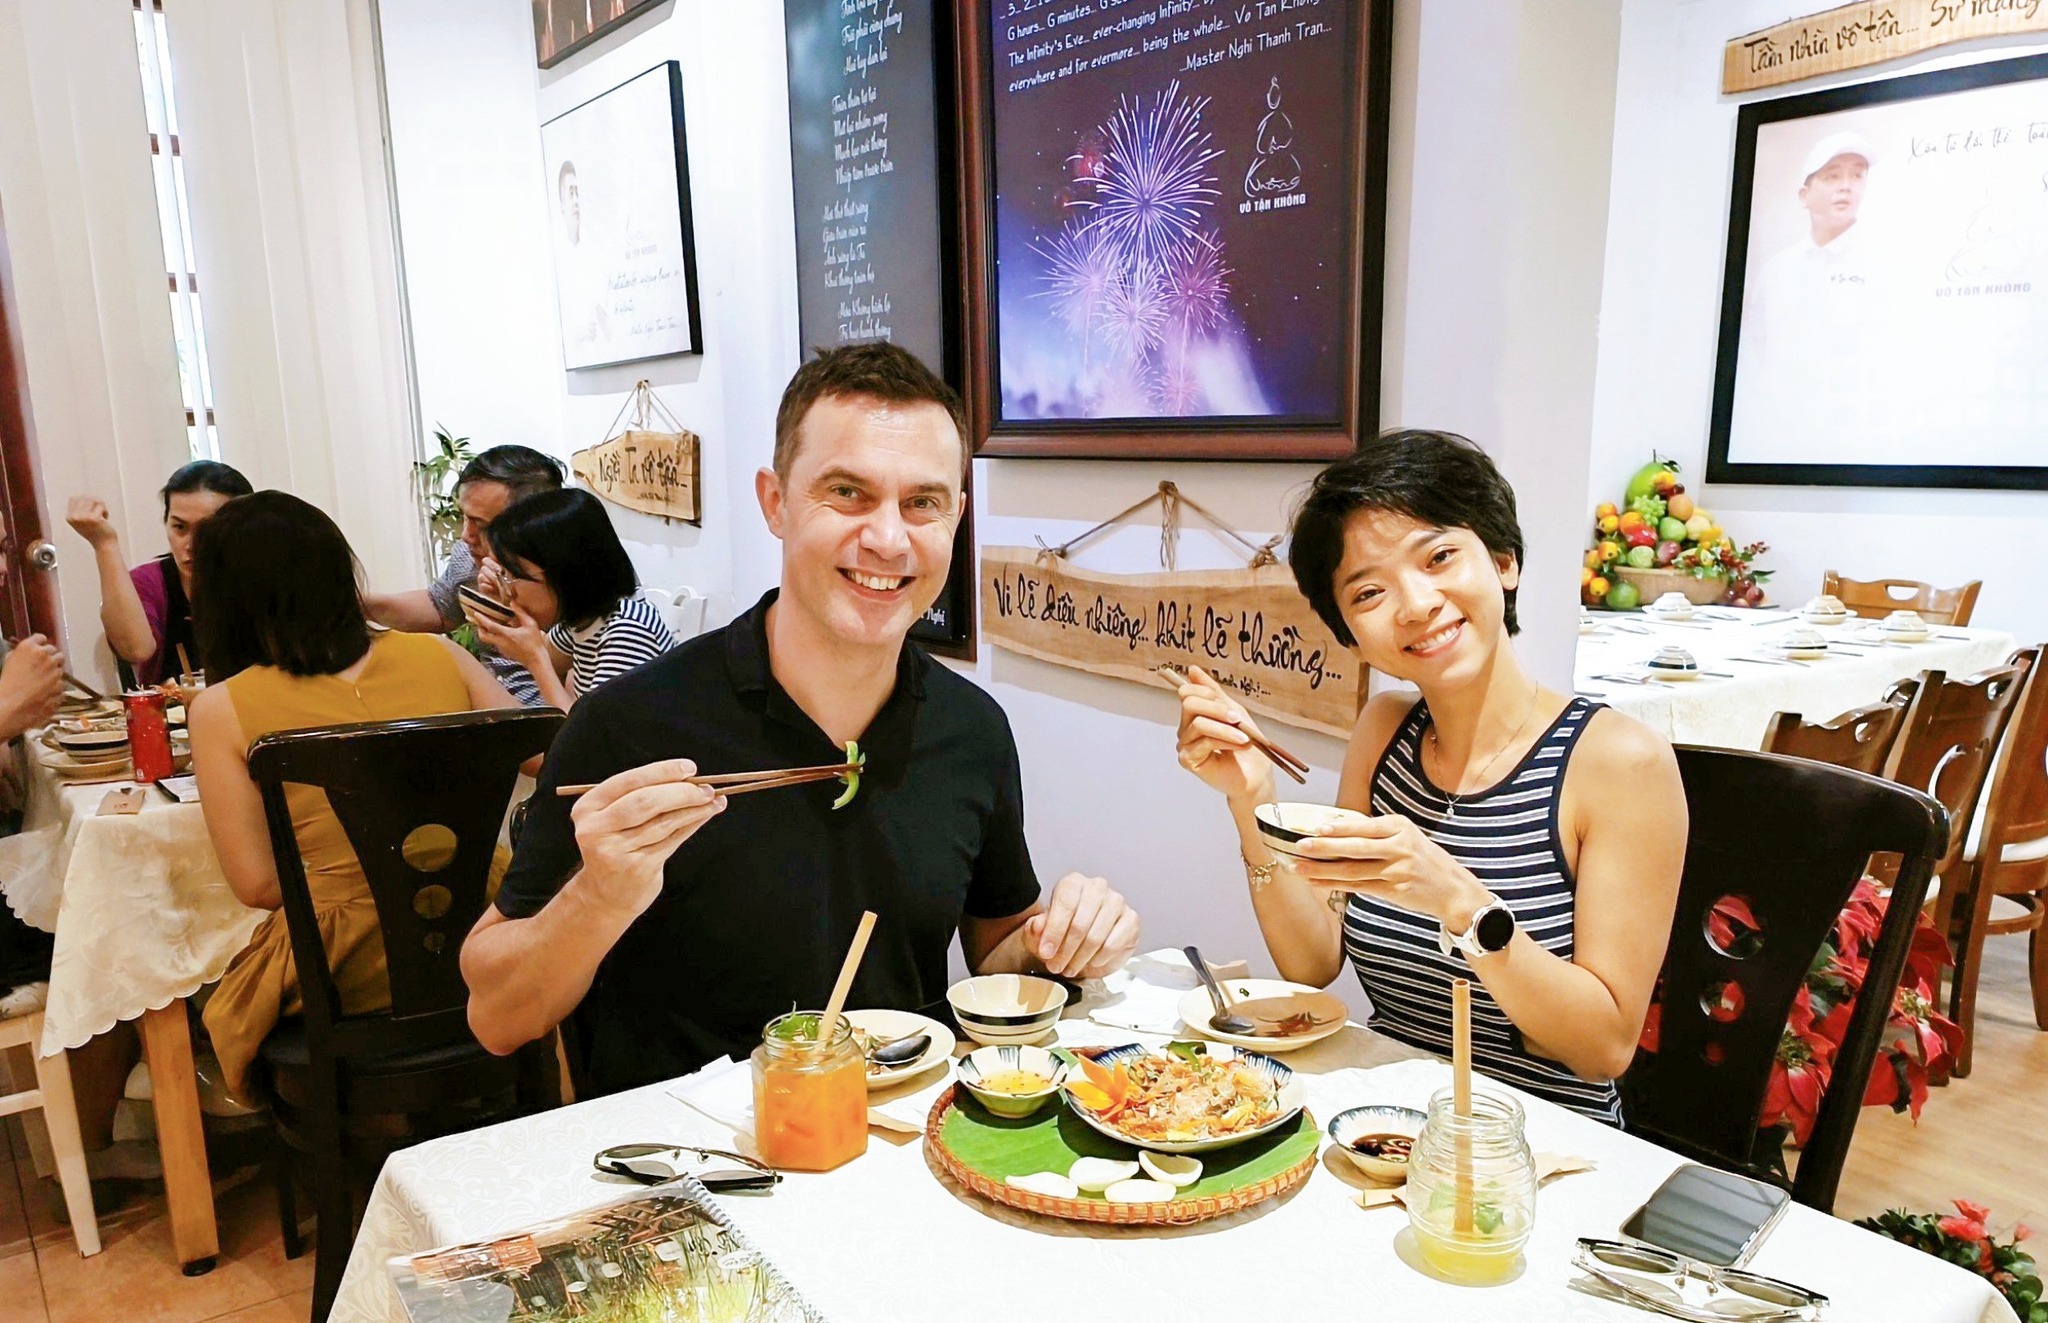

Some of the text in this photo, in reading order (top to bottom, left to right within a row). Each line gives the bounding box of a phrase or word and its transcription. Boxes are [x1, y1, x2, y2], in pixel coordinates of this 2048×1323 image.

[1008, 53, 1024, 67] The
[1026, 39, 1063, 61] Infinity's
[1092, 11, 1157, 40] ever-changing
[1008, 70, 1055, 92] everywhere
[1058, 61, 1073, 78] and
[1075, 58, 1088, 74] for
[1143, 36, 1169, 54] being
[1173, 28, 1189, 44] the
[1235, 4, 1251, 24] Vo
[1256, 2, 1277, 20] Tan
[1229, 38, 1253, 59] Nghi
[1257, 27, 1291, 51] Thanh
[1790, 28, 1829, 62] nhìn
[1239, 193, 1306, 214] VÔ TẬN KHÔNG
[1017, 573, 1040, 620] lẽ
